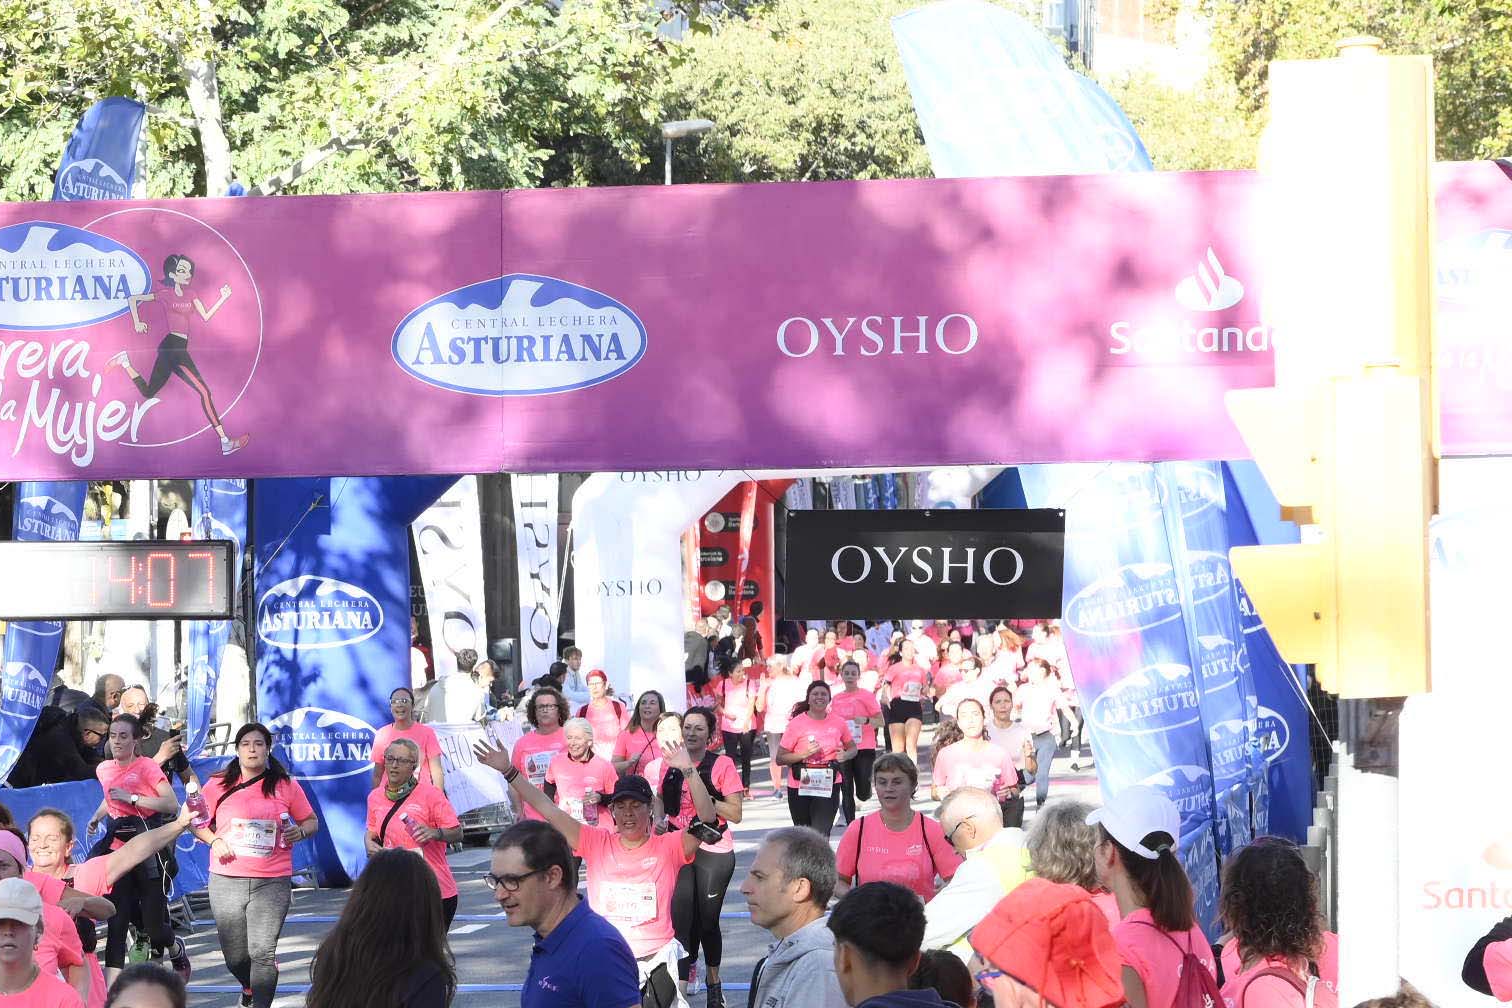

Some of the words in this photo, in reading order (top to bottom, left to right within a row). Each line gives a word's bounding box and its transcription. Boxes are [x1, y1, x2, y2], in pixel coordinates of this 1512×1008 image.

[54, 257, 126, 270] LECHERA
[451, 317, 529, 329] CENTRAL
[538, 314, 618, 327] LECHERA
[776, 313, 979, 358] OYSHO
[411, 321, 627, 365] ASTURIANA
[11, 375, 161, 468] Mujer
[830, 545, 1025, 586] OYSHO
[260, 605, 374, 632] ASTURIANA
[320, 599, 369, 608] LECHERA
